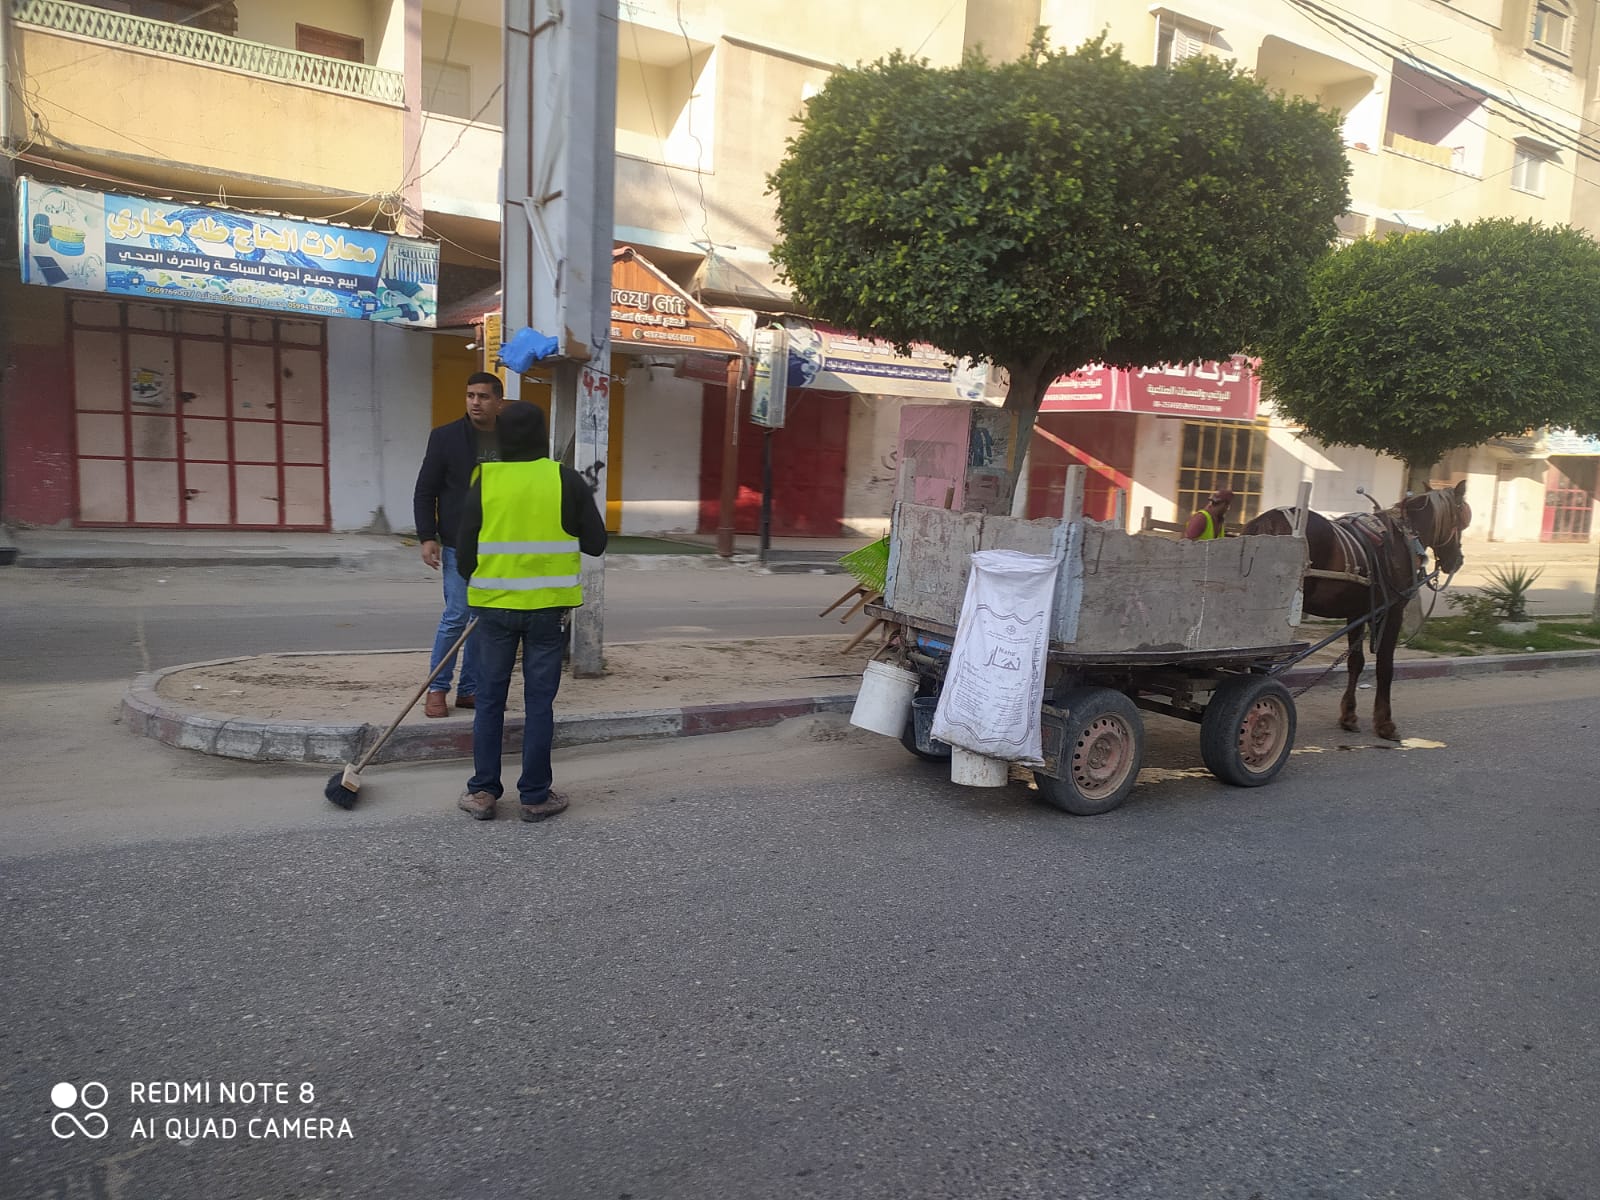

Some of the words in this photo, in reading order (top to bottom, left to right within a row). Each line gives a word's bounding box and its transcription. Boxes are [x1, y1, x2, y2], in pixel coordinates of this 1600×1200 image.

[189, 216, 230, 242] طه
[233, 223, 298, 253] الحاج
[301, 230, 376, 263] محلات
[118, 250, 163, 264] الصحي
[166, 254, 211, 271] والصرف
[268, 268, 300, 282] أدوات
[303, 273, 335, 288] جميع
[337, 278, 358, 289] لبيع
[610, 289, 650, 311] razy
[652, 295, 687, 315] Gift
